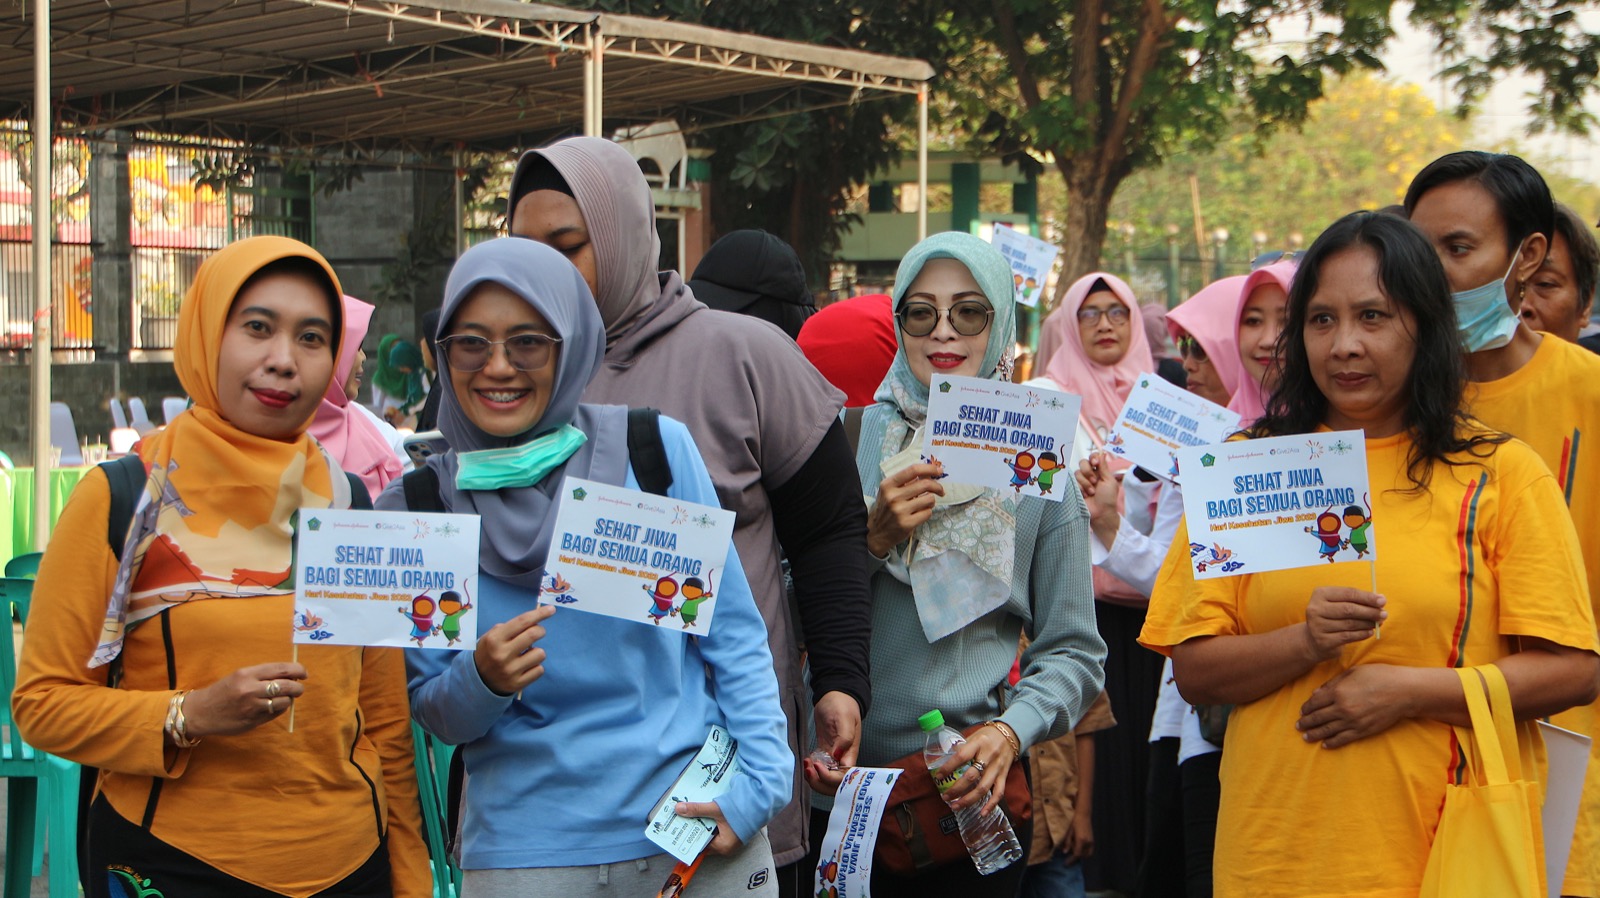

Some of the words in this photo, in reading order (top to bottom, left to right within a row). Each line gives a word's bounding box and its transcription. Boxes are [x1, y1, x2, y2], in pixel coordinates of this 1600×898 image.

[958, 405, 1000, 424] SEHAT
[1000, 411, 1032, 430] JIWA
[1126, 408, 1147, 424] BAGI
[1146, 416, 1178, 441] SEMUA
[1146, 401, 1178, 422] SEHAT
[1176, 414, 1199, 434] JIWA
[933, 420, 961, 437] BAGI
[963, 424, 1007, 443] SEMUA
[1010, 430, 1055, 451] ORANG
[1234, 472, 1282, 494] SEHAT
[1287, 468, 1324, 488] JIWA
[1206, 498, 1242, 519] BAGI
[1246, 491, 1301, 515] SEMUA
[1304, 488, 1355, 507] ORANG
[594, 518, 641, 542] SEHAT
[643, 527, 677, 551] JIWA
[1210, 522, 1227, 532] Hari
[1228, 518, 1272, 530] Kesehatan
[1274, 516, 1294, 525] Jiwa
[335, 545, 384, 564] SEHAT
[387, 547, 424, 566] JIWA
[558, 555, 575, 565] Hari
[618, 567, 636, 577] Jiwa
[561, 532, 597, 555] BAGI
[598, 540, 649, 567] SEMUA
[651, 551, 702, 576] ORANG
[305, 566, 340, 585] BAGI
[344, 567, 397, 587] SEMUA
[402, 570, 454, 590] ORANG
[324, 591, 367, 600] Kesehatan
[369, 592, 389, 600] Jiwa
[858, 771, 877, 801] BAGI
[844, 804, 863, 850] SEMUA
[857, 795, 874, 839] SEHAT
[848, 842, 861, 874] JIWA
